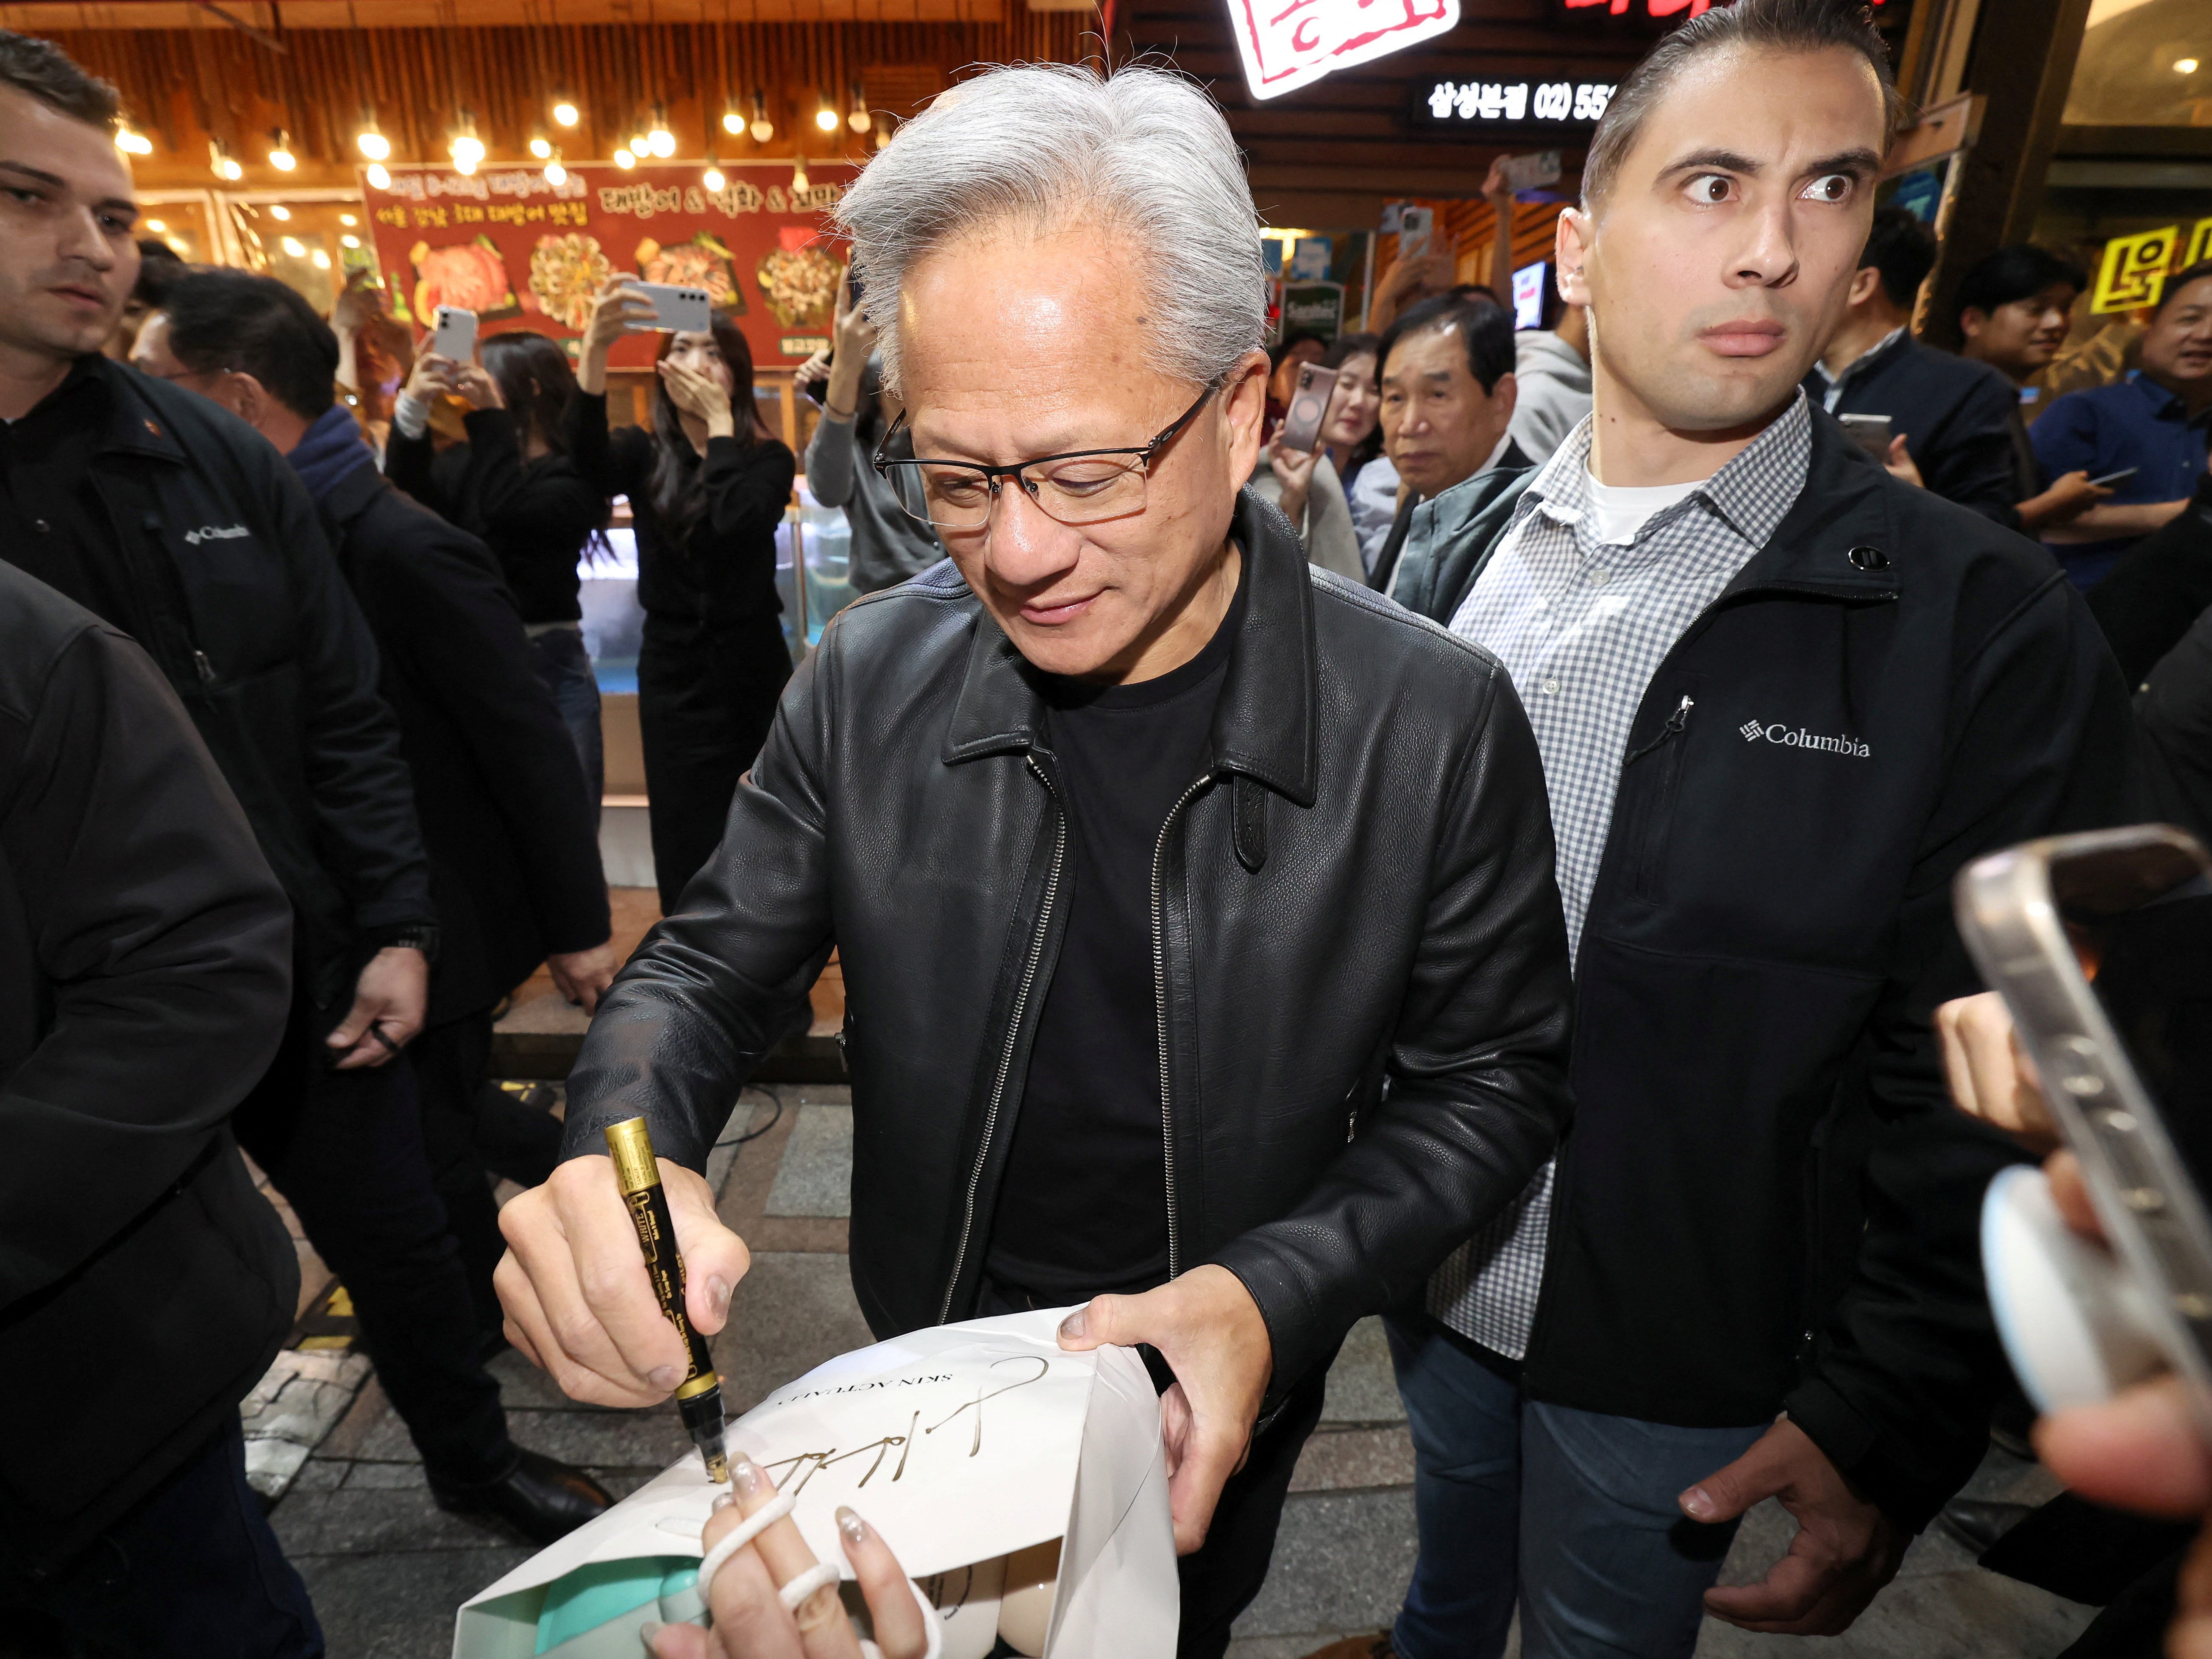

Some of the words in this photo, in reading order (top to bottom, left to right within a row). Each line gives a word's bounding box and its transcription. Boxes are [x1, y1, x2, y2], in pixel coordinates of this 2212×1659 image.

[1428, 82, 1528, 120] 삼성본점
[1573, 84, 1618, 120] 55
[548, 201, 588, 226] 맛집
[599, 183, 681, 218] 대방어
[684, 186, 706, 214] &
[765, 185, 787, 213] &
[1765, 724, 1870, 757] Columbia
[636, 1212, 650, 1243] WRITE
[898, 1374, 953, 1386] SKIN
